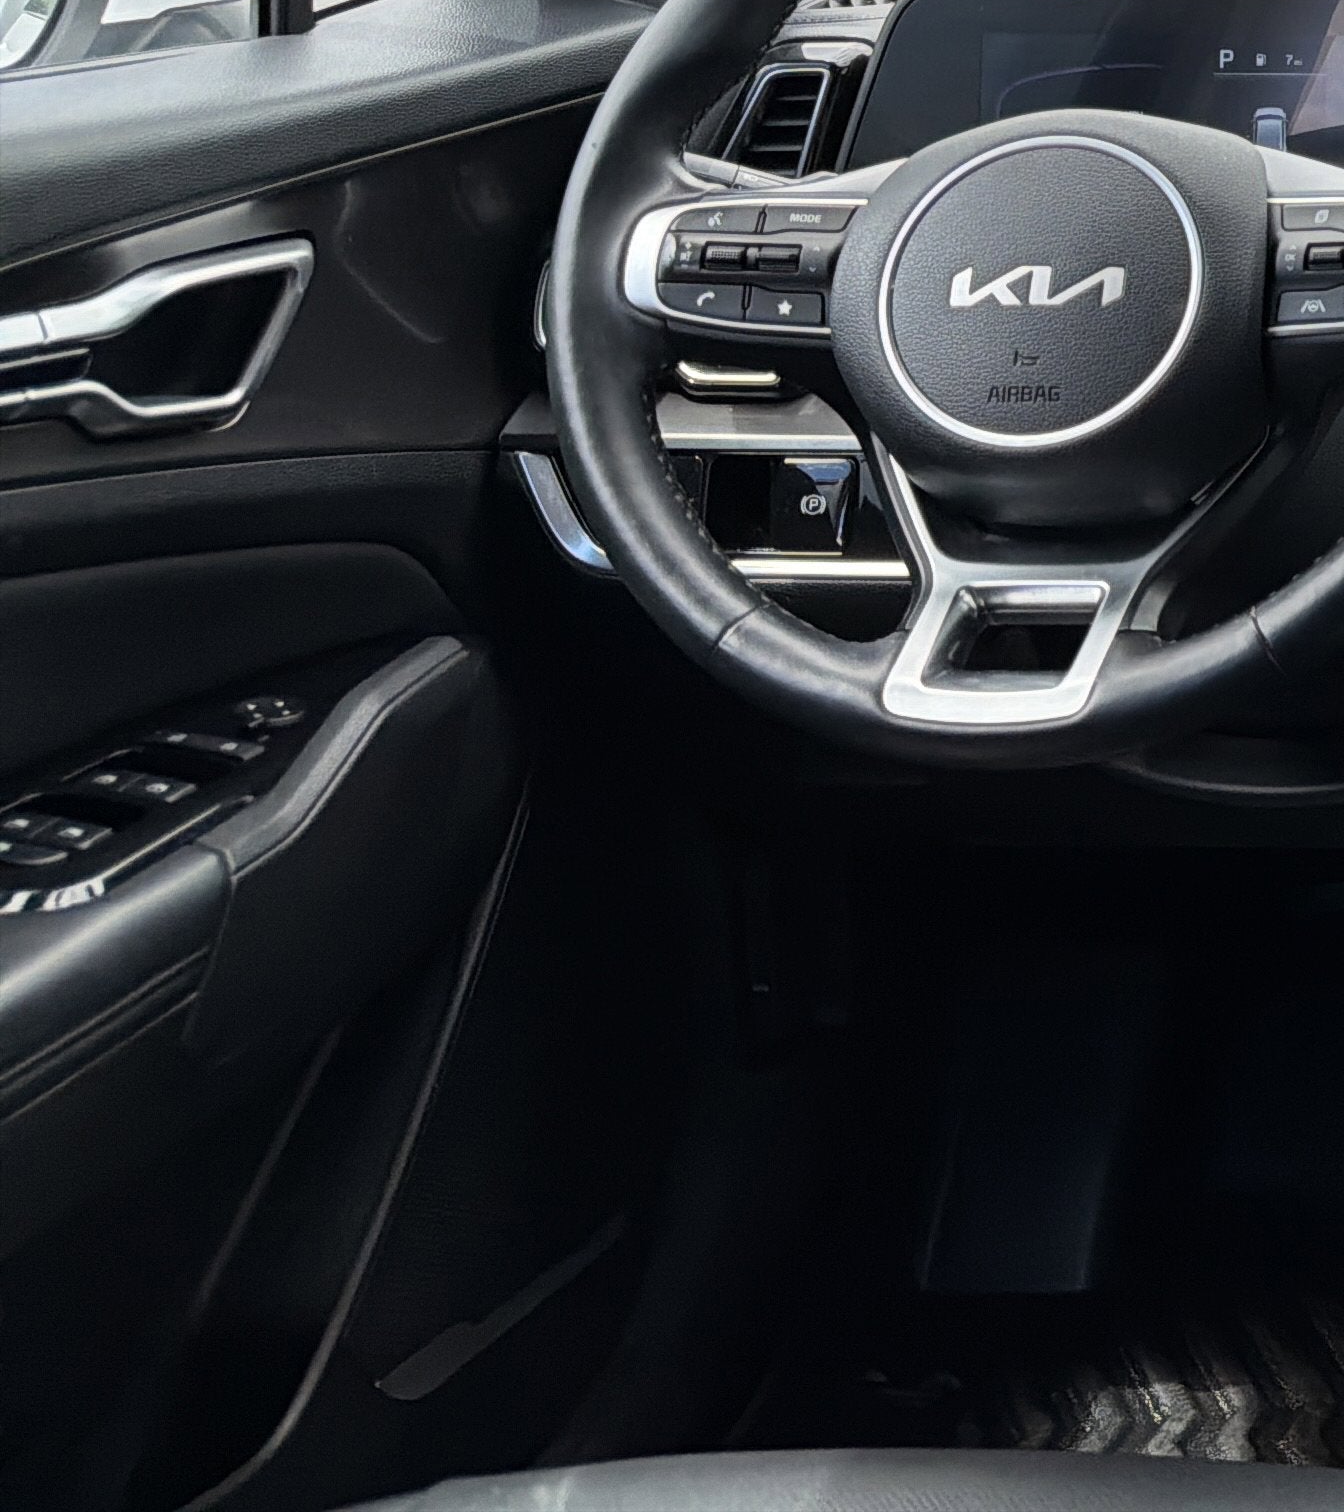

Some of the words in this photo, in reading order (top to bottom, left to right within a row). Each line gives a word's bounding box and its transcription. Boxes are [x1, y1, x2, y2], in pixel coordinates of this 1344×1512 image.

[1219, 49, 1235, 69] P
[788, 212, 823, 225] MODE
[949, 266, 1126, 308] KIA
[986, 384, 1062, 404] AIRBAG
